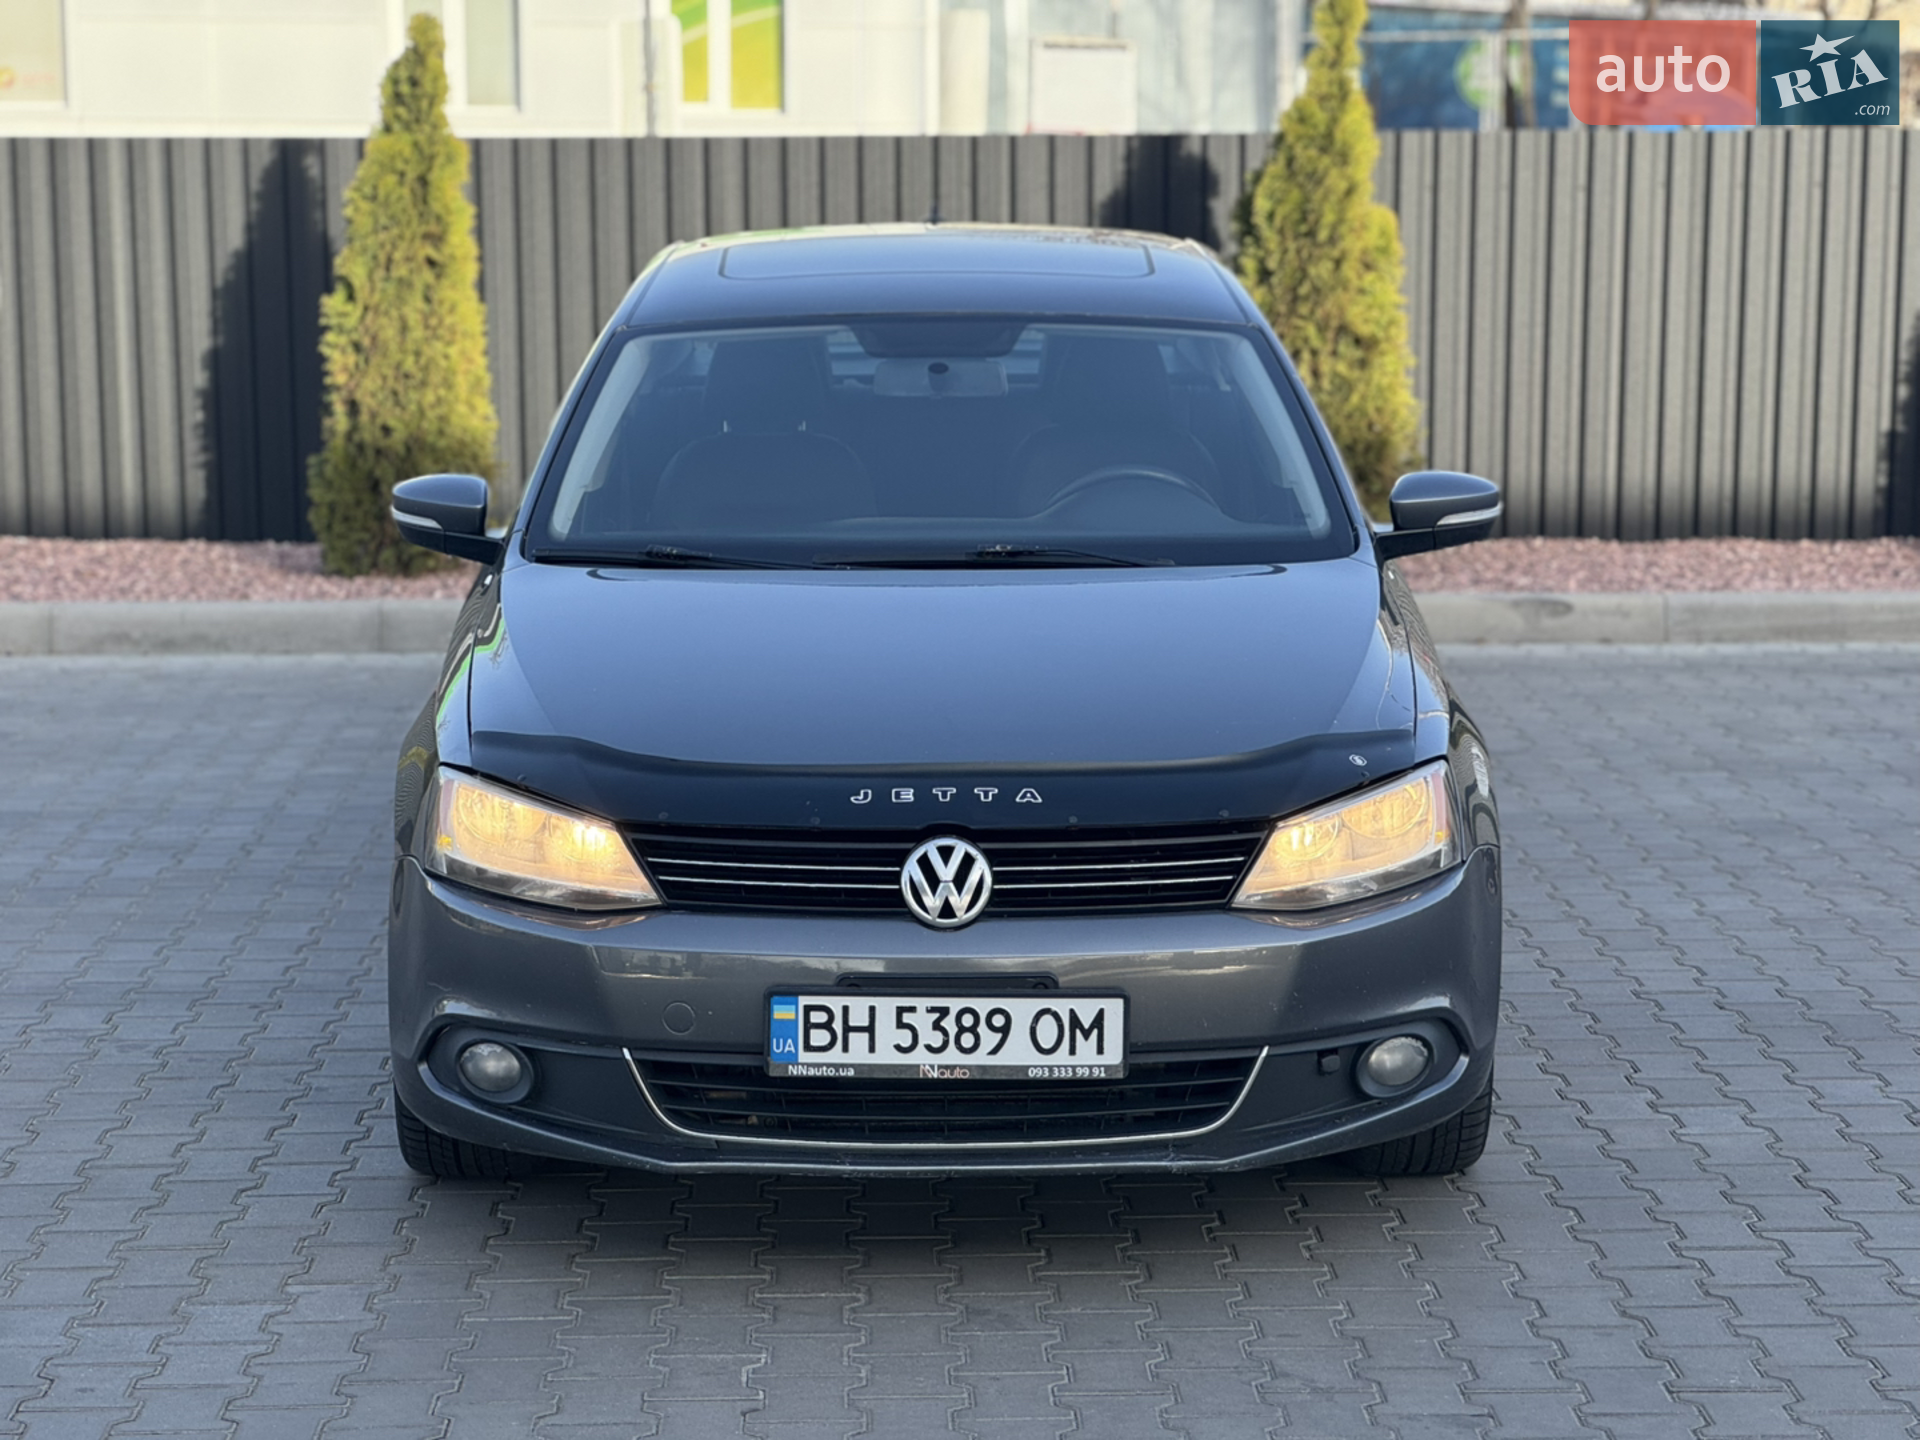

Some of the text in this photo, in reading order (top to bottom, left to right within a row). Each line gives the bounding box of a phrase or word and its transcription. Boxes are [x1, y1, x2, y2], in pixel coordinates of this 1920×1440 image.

[850, 787, 1043, 804] JETTA
[802, 1003, 1105, 1056] BH 5389 OM
[772, 1038, 796, 1054] UA
[787, 1064, 855, 1077] NNauto.ua
[1028, 1066, 1106, 1078] 093 333 99 91
